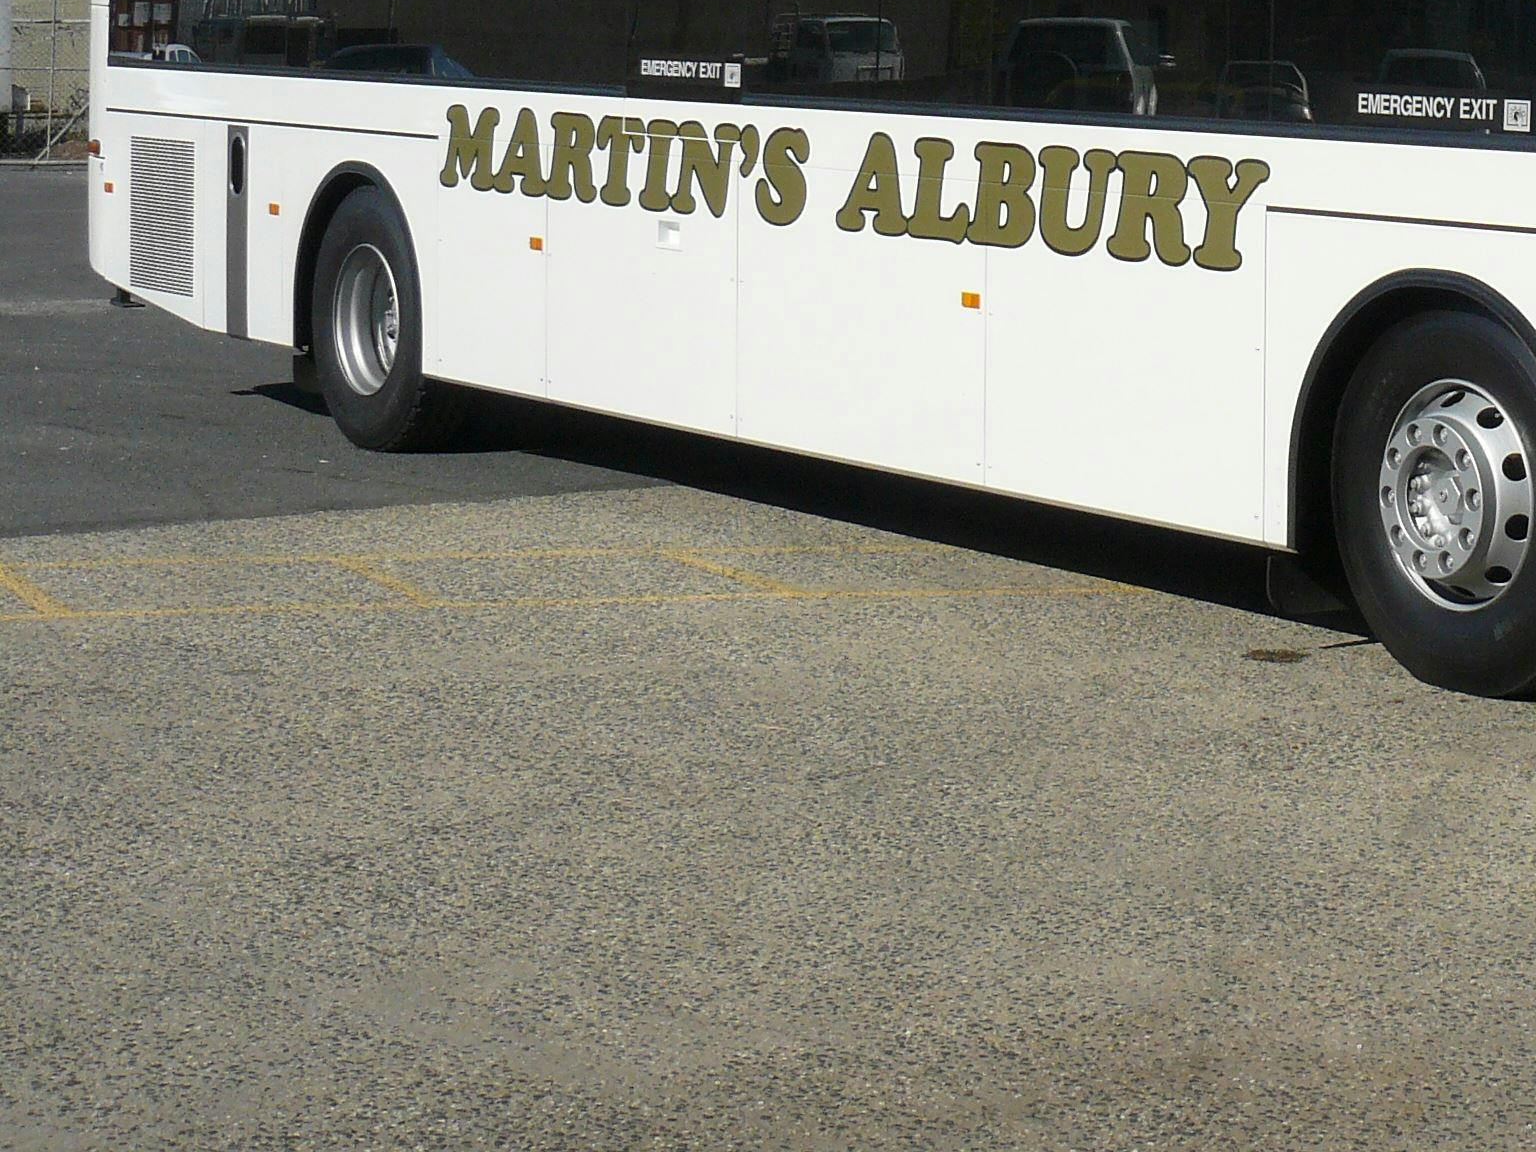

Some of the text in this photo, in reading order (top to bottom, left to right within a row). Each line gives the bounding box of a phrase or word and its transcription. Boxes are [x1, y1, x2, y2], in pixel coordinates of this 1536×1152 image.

[641, 59, 722, 79] EMERGENCY EXIT
[1358, 93, 1498, 120] EMERGENCY EXIT
[439, 104, 1271, 272] MARTIN'S ALBURY
